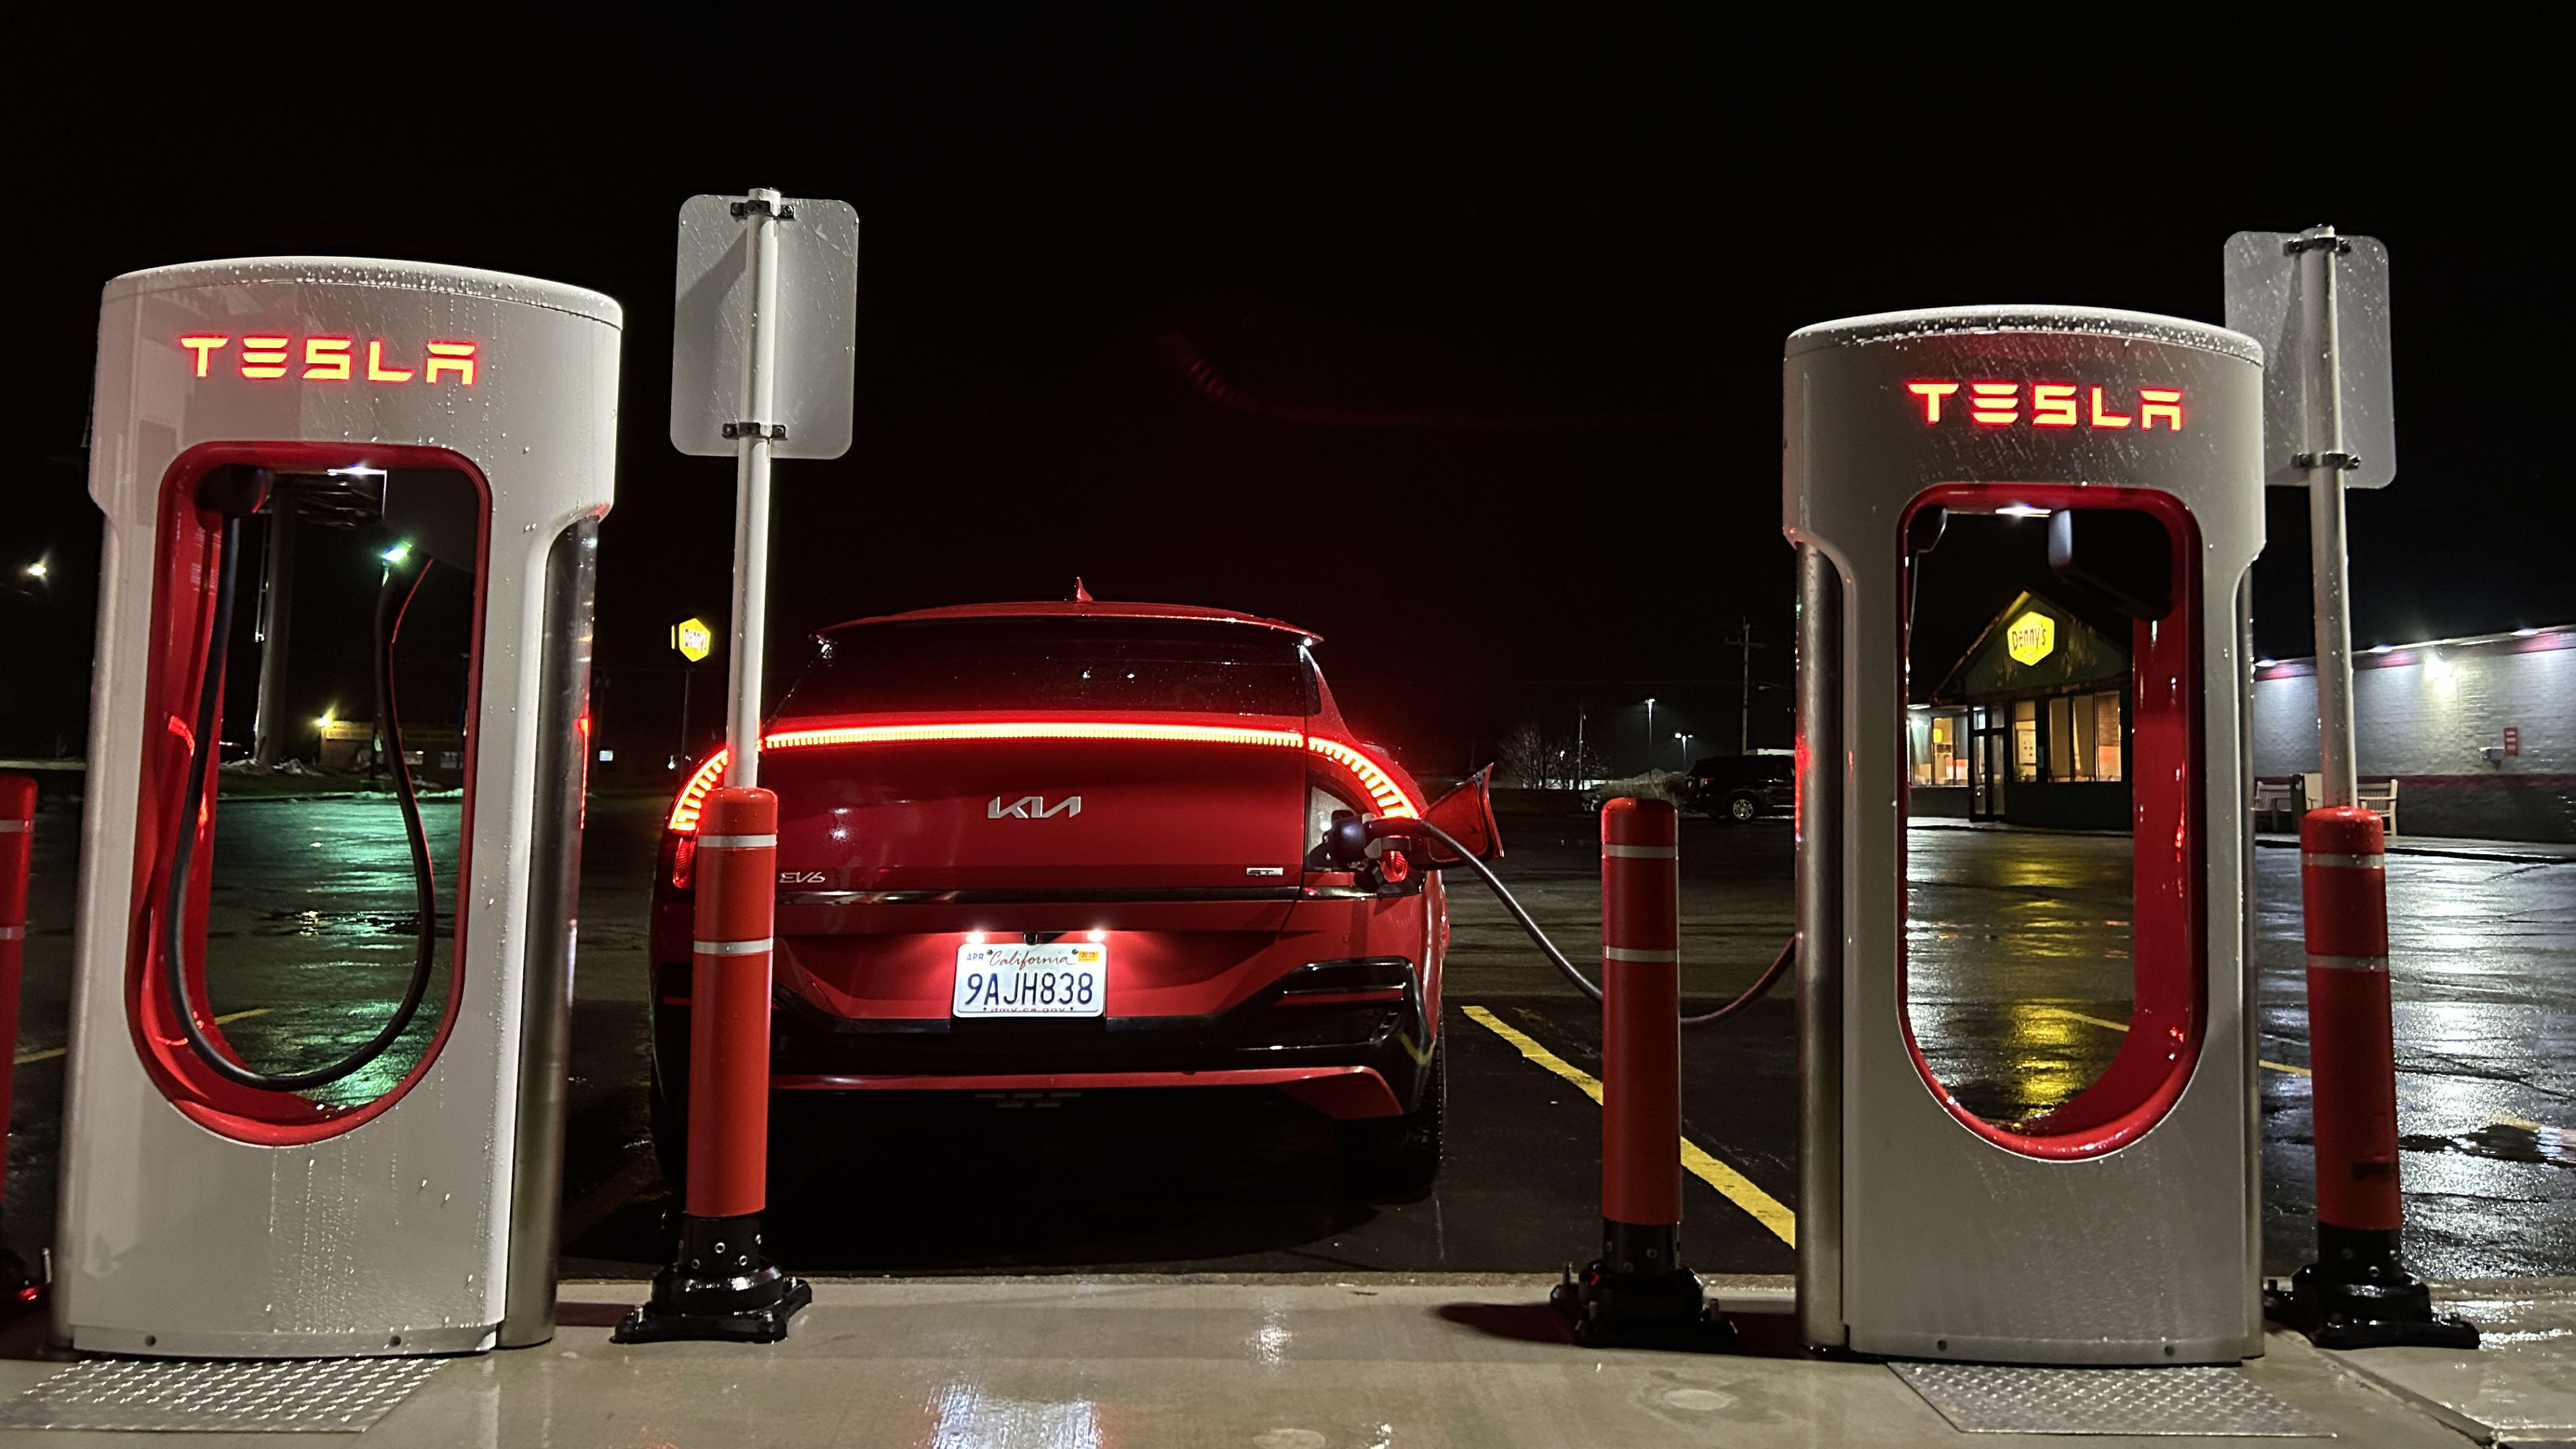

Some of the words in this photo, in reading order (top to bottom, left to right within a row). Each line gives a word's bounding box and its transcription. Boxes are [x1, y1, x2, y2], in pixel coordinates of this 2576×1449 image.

[180, 335, 477, 385] TESLA
[1906, 381, 2183, 431] TESLA
[2012, 623, 2047, 651] Denny's
[987, 796, 1081, 819] KIA
[779, 871, 826, 883] EV6
[966, 953, 984, 961] APR
[989, 950, 1077, 971] California
[965, 972, 1093, 1005] 9AJH838
